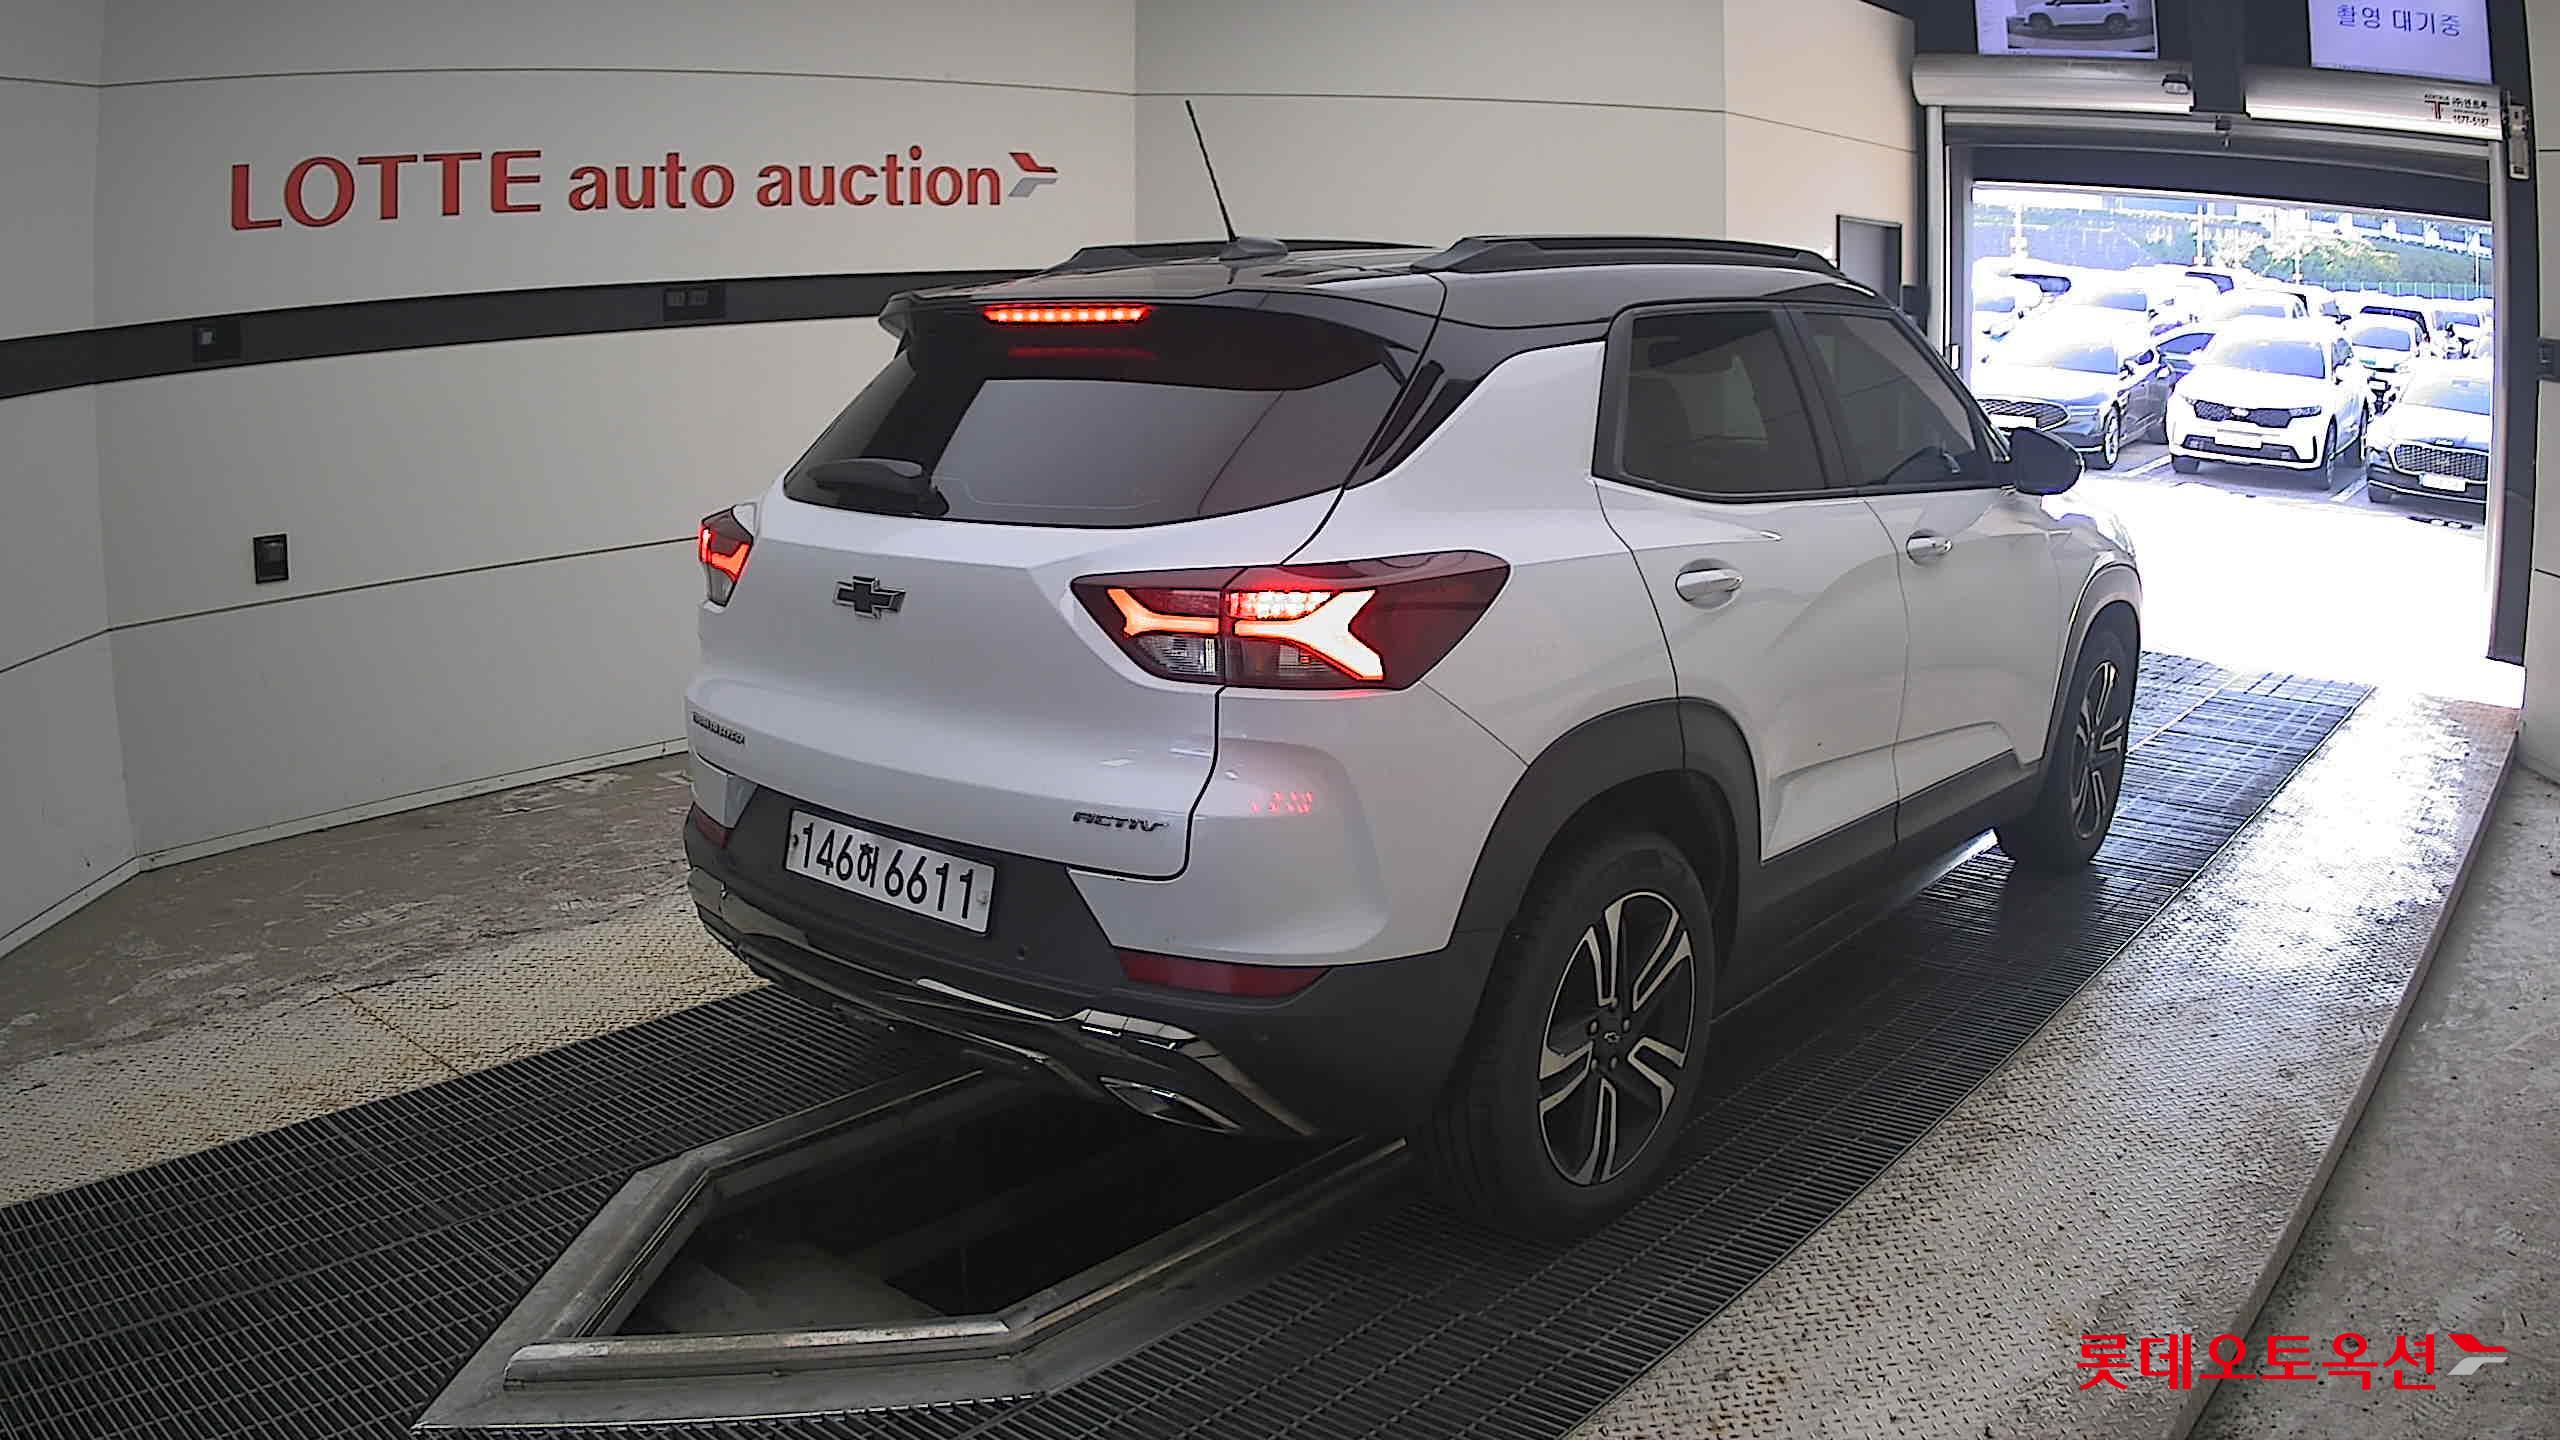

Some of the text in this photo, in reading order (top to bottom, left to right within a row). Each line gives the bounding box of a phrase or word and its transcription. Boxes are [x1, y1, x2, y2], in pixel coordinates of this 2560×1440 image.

[2337, 4, 2460, 37] 촬영 대기중
[230, 145, 1002, 231] LOTTE auto auction
[1072, 812, 1169, 832] ACTIV
